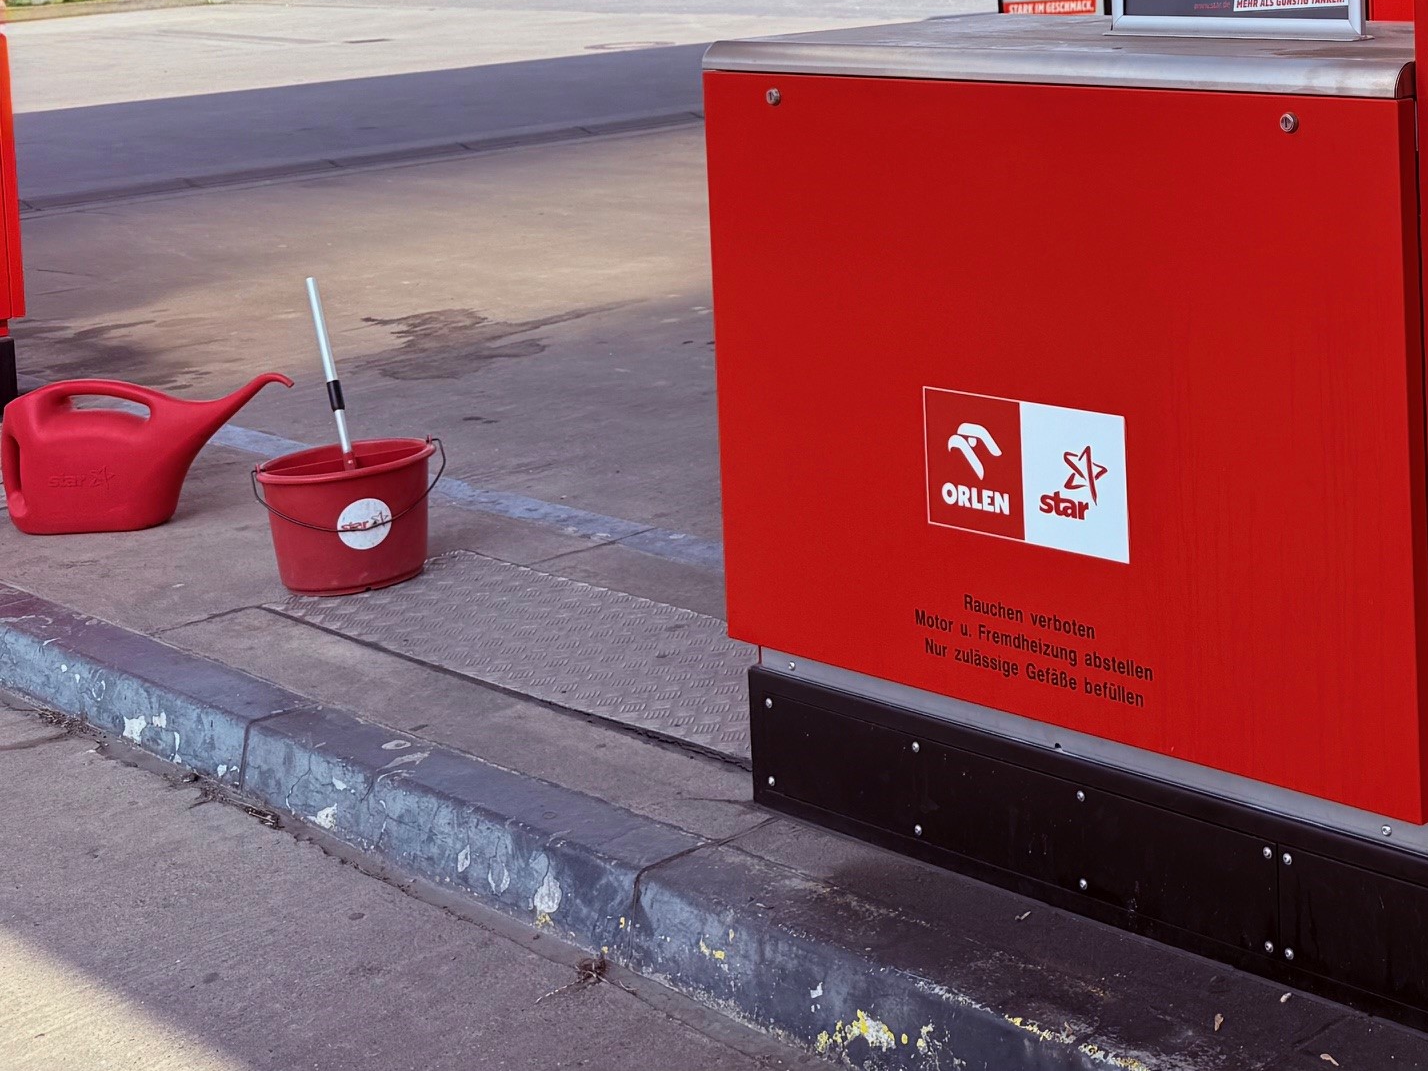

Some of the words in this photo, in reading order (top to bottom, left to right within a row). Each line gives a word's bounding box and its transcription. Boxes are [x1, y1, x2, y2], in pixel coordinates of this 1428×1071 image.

[1008, 3, 1034, 14] STARK
[1034, 2, 1044, 14] IM
[942, 482, 1010, 516] ORLEN
[1039, 490, 1090, 521] star
[963, 593, 1023, 623] Rauchen
[1030, 612, 1096, 640] verboten
[914, 608, 953, 633] Motor
[960, 623, 972, 638] u.
[978, 623, 1078, 668] Fremdheizung
[1084, 650, 1154, 681] abstellen
[924, 637, 948, 658] Nur
[954, 647, 1020, 678] zulässige
[1025, 662, 1078, 691] Gefäße
[1084, 676, 1145, 708] befüllen
